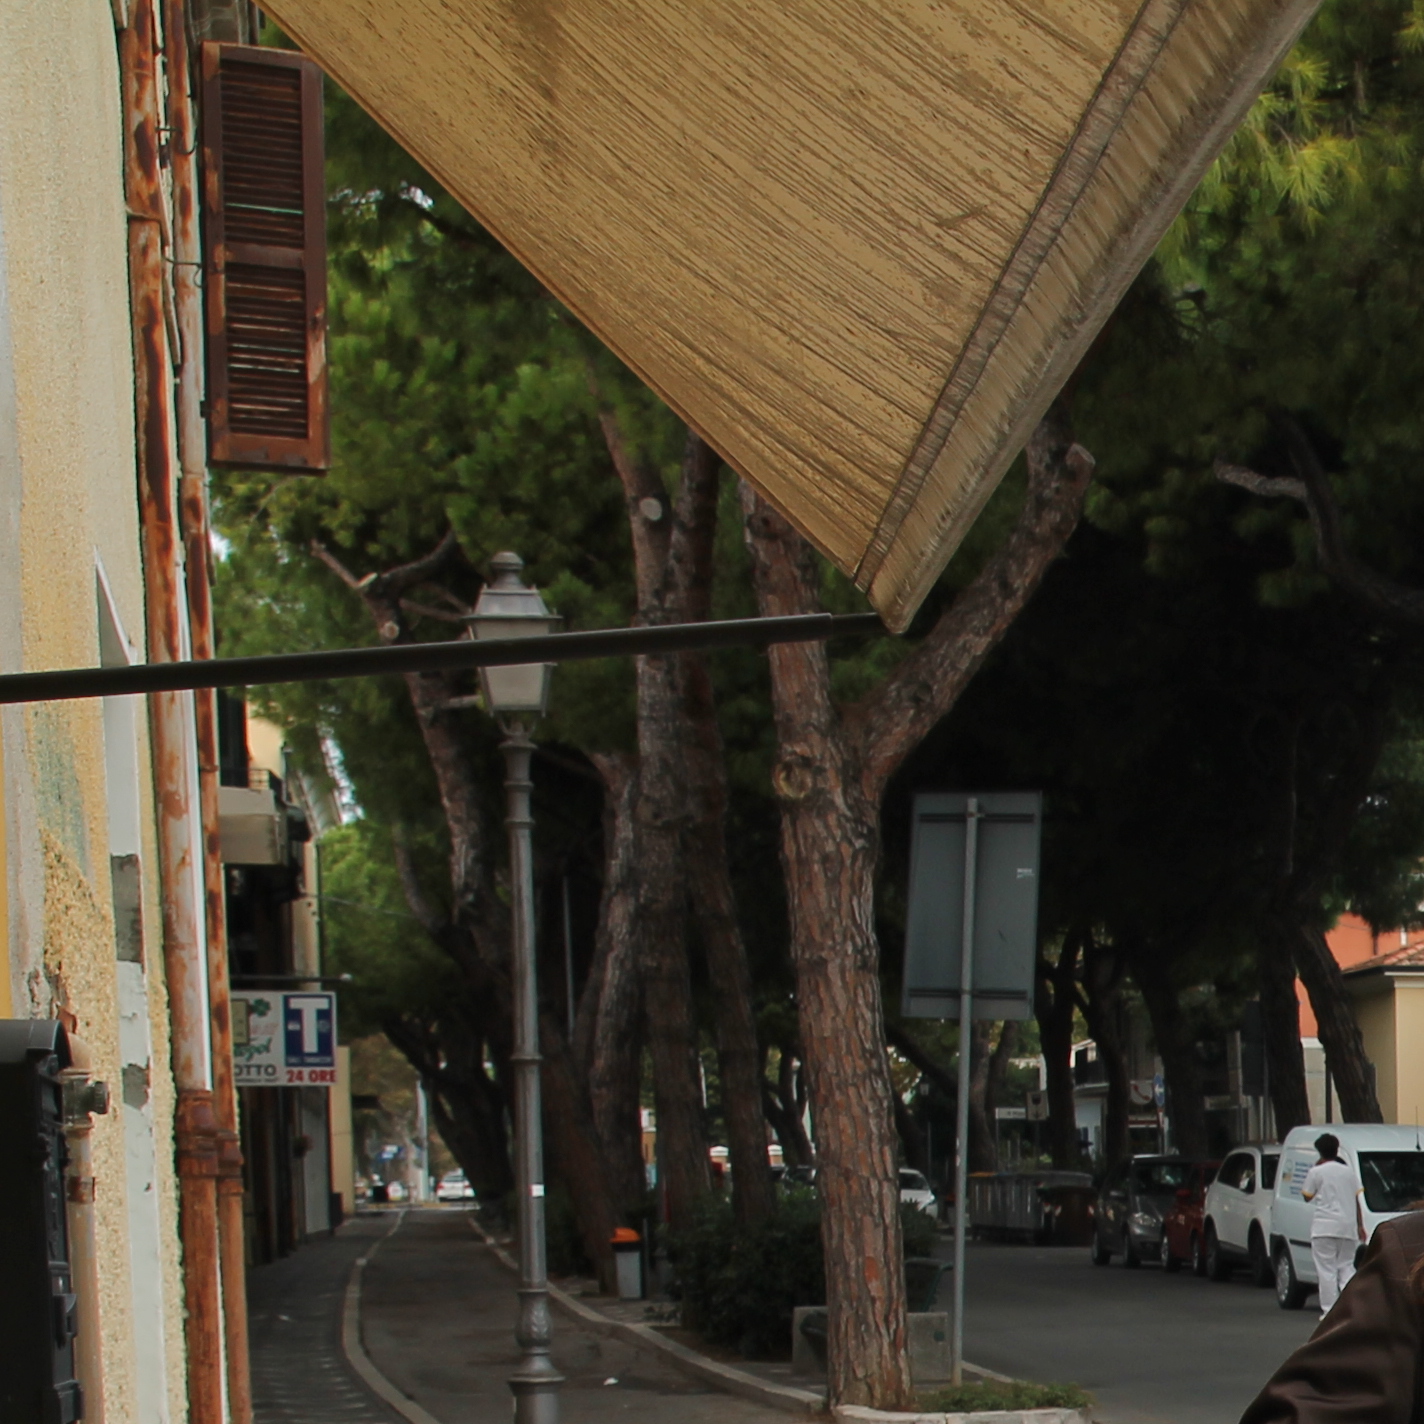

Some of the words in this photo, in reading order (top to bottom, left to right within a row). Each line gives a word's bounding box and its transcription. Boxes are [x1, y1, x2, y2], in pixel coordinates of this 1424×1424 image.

[289, 997, 329, 1053] T
[286, 1070, 303, 1083] 24
[309, 1070, 336, 1083] ORE
